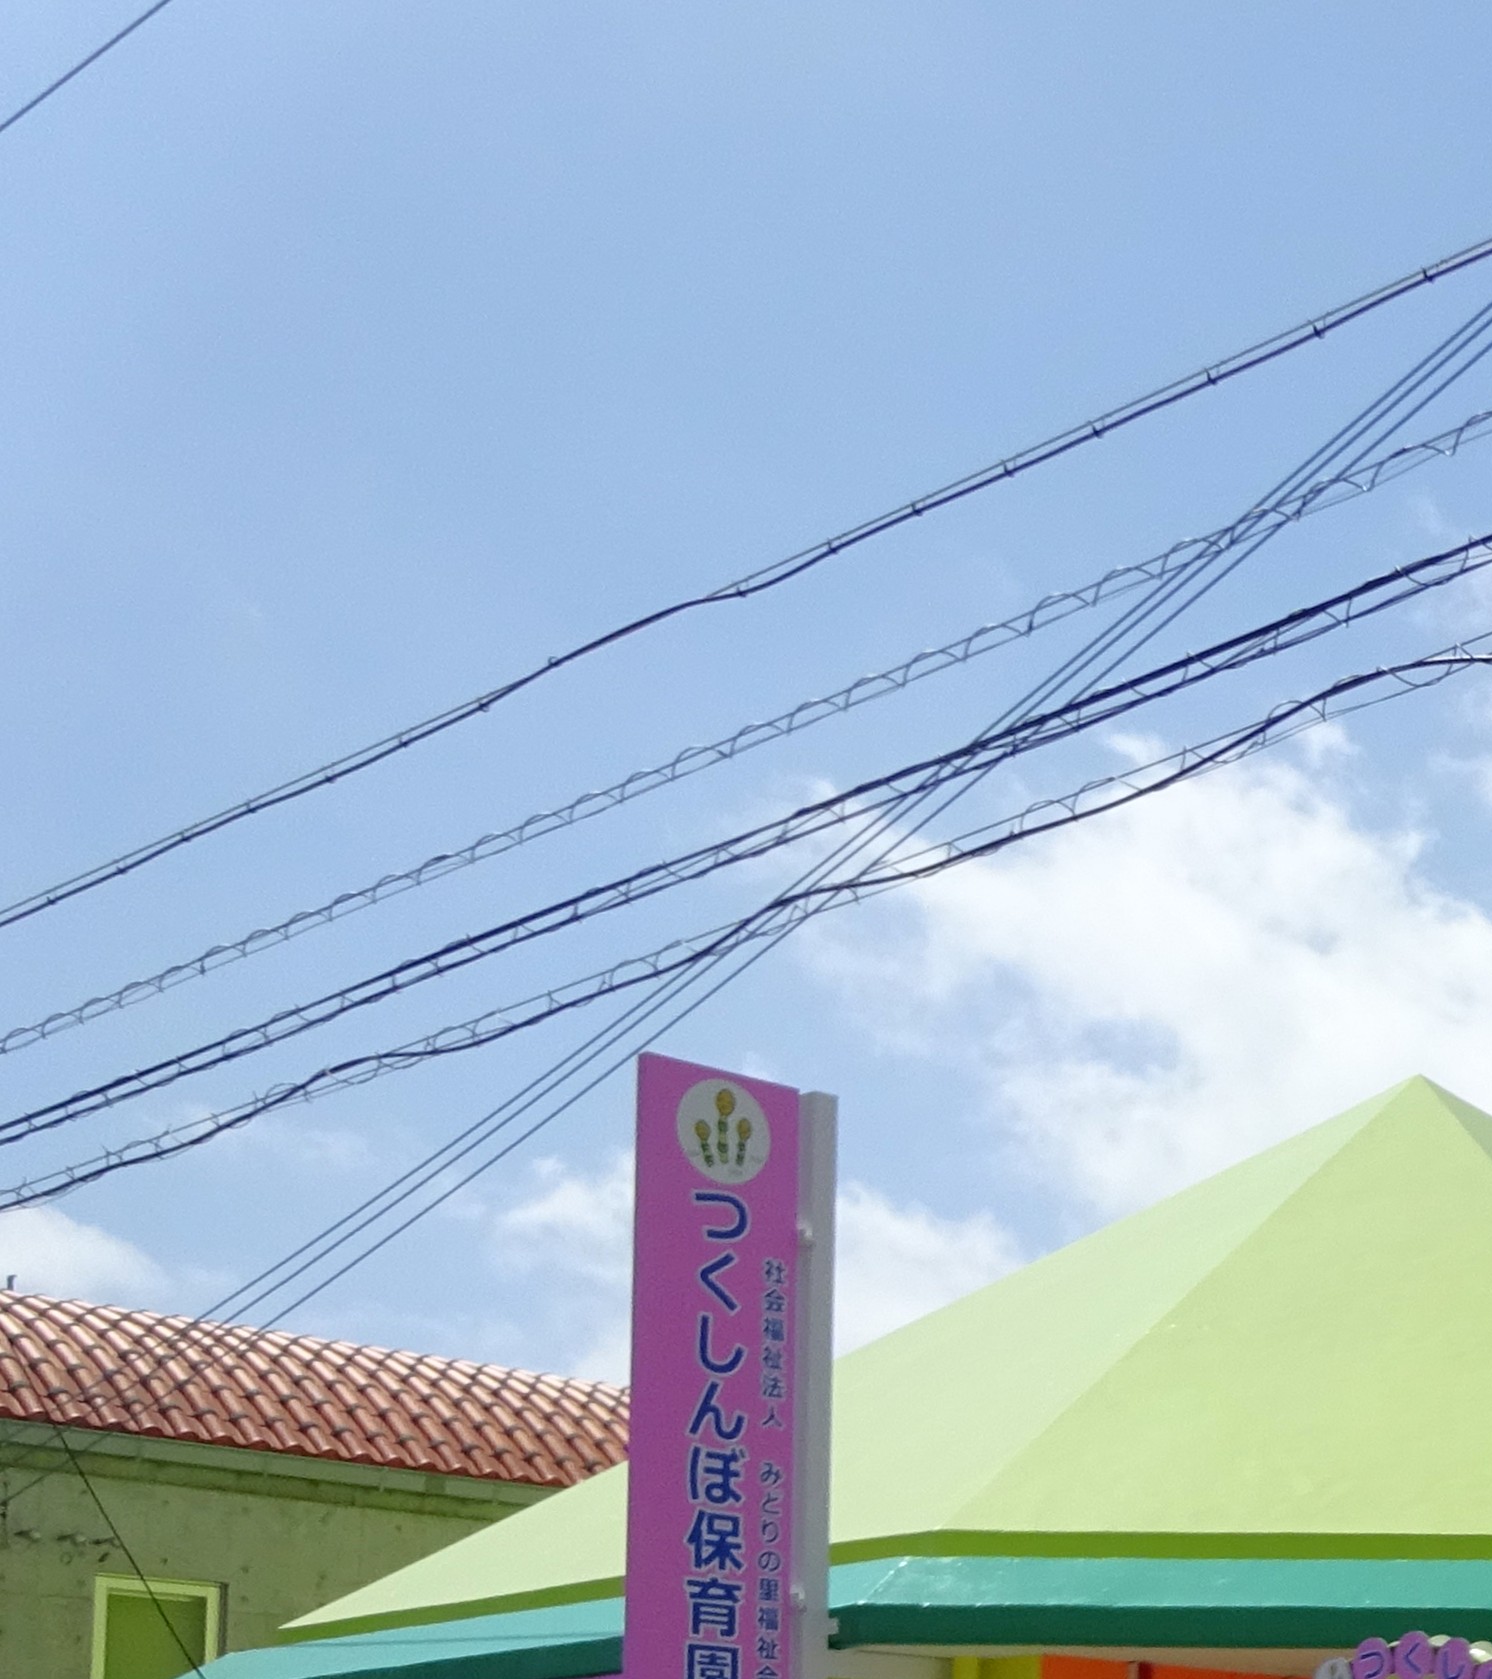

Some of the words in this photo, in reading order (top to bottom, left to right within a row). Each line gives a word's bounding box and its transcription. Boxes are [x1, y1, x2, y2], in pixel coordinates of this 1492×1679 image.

[761, 1259, 787, 1429] 社会福祉法人
